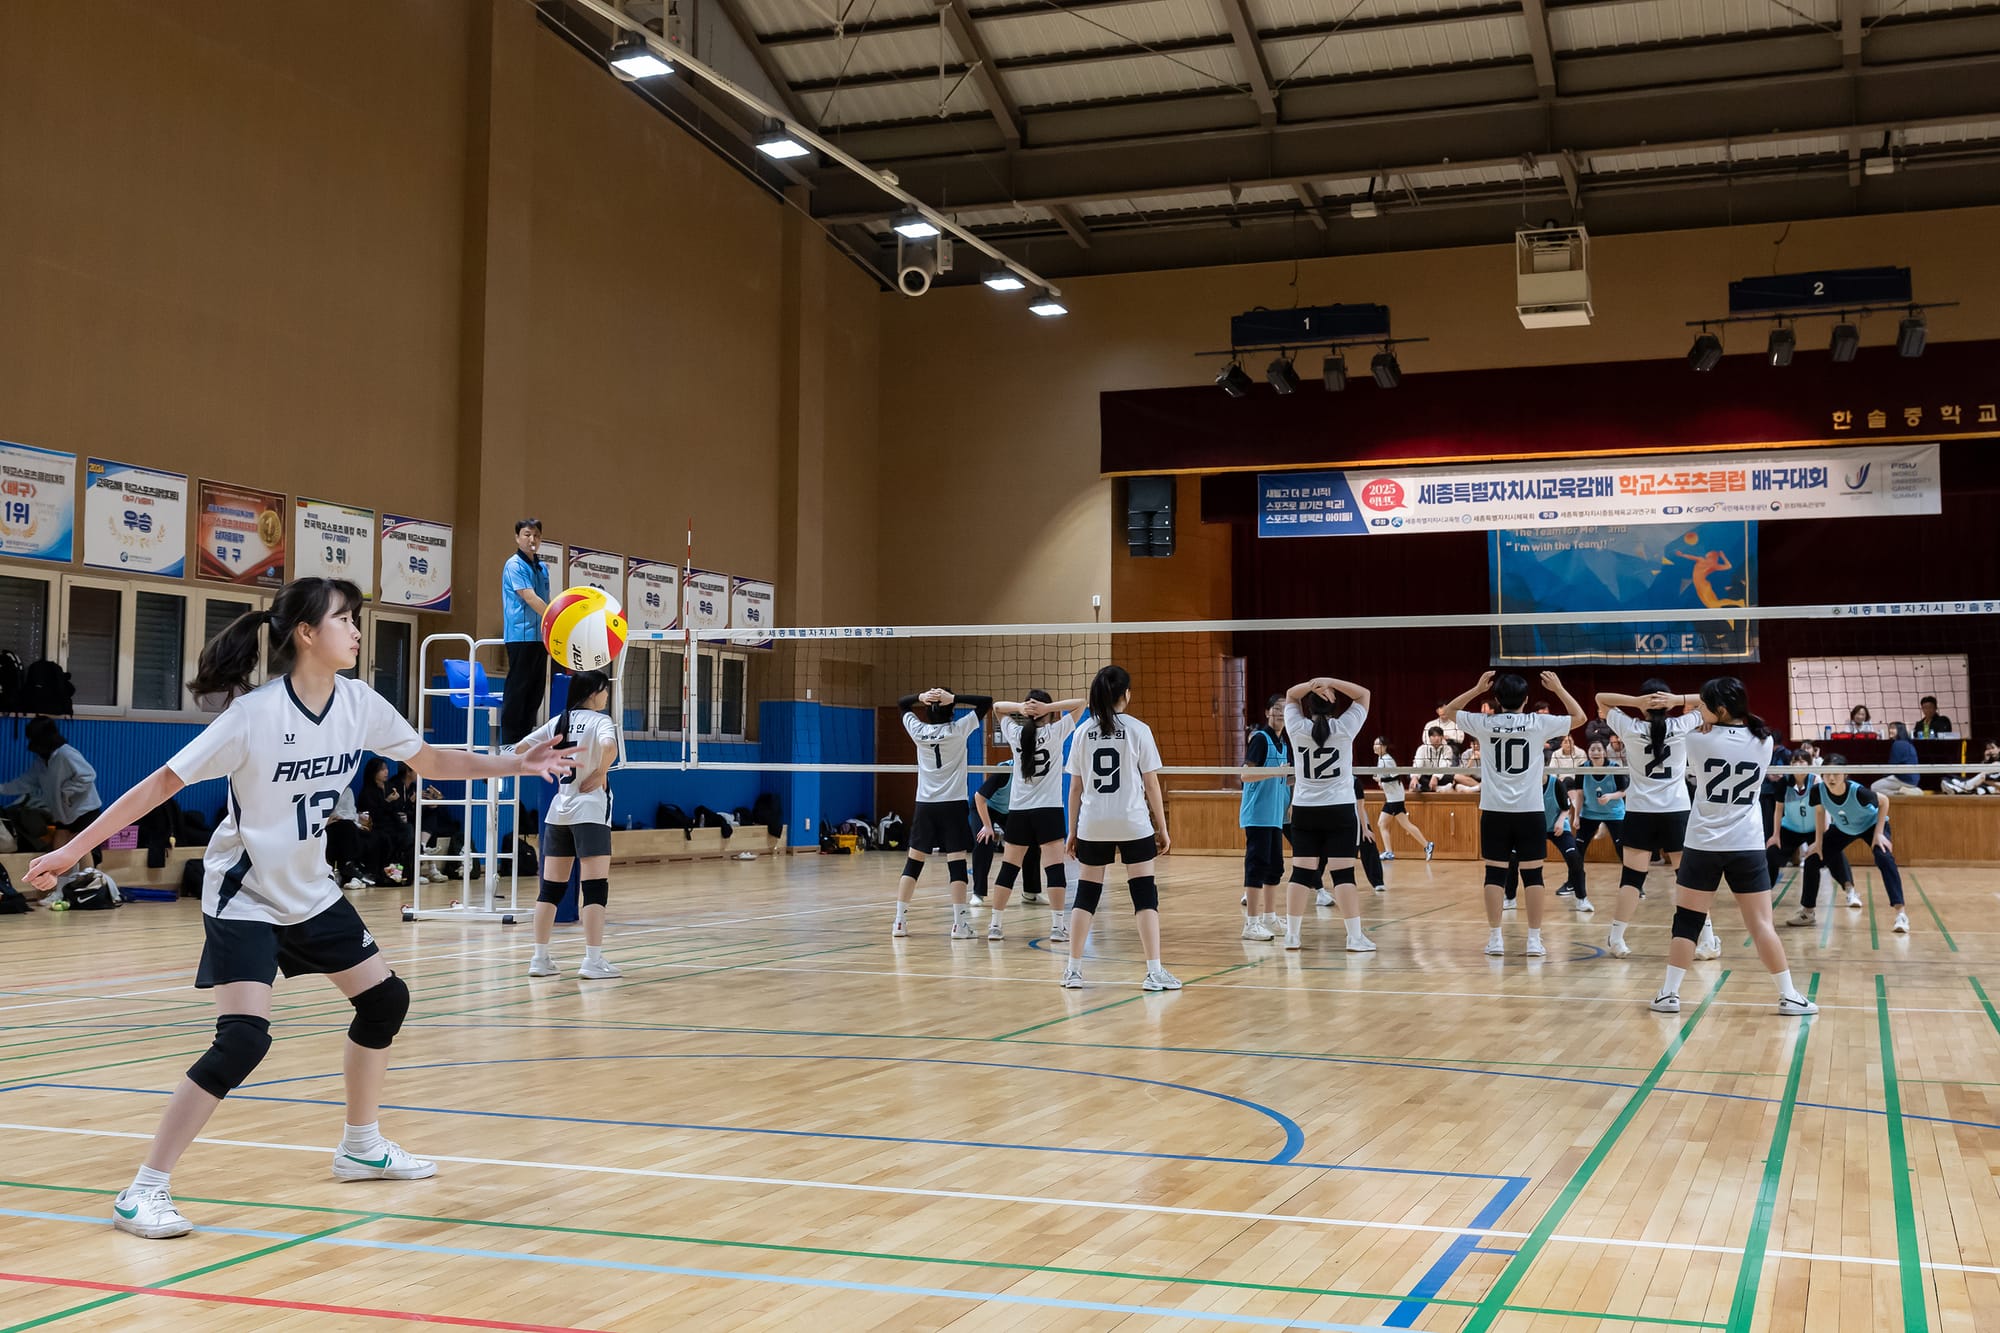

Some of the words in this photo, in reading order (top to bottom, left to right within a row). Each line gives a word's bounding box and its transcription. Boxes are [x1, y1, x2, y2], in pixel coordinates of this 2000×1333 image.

[1814, 281, 1825, 296] 2
[1303, 316, 1310, 330] 1
[1832, 404, 1998, 430] 한솔중학교
[1368, 483, 1396, 496] 2025
[1418, 476, 1614, 505] 세종특별자치시교육감배
[1619, 470, 1746, 496] 학교스포츠클럽
[1752, 467, 1828, 491] 배구대회
[5, 500, 30, 525] 1위
[1265, 501, 1297, 511] 스포츠로
[124, 510, 153, 534] 우승
[1265, 514, 1297, 524] 스포츠로
[1535, 527, 1562, 537] Team
[1532, 541, 1553, 552] with
[1554, 541, 1571, 551] the
[408, 556, 429, 575] 우승
[1847, 603, 1944, 616] 세종특별자치시
[1954, 602, 2000, 613] 한솔중
[768, 628, 837, 638] 세종특별자치시
[844, 627, 894, 637] 한솔중학교
[1634, 633, 1710, 653] KOE
[1298, 746, 1341, 779] 12
[1490, 736, 1530, 774] 10
[1644, 744, 1673, 779] 2
[272, 749, 362, 782] AREUM
[1093, 747, 1121, 793] 9
[1703, 758, 1761, 805] 22
[292, 790, 342, 841] 13
[1799, 805, 1807, 817] 6
[1840, 814, 1850, 826] 3
